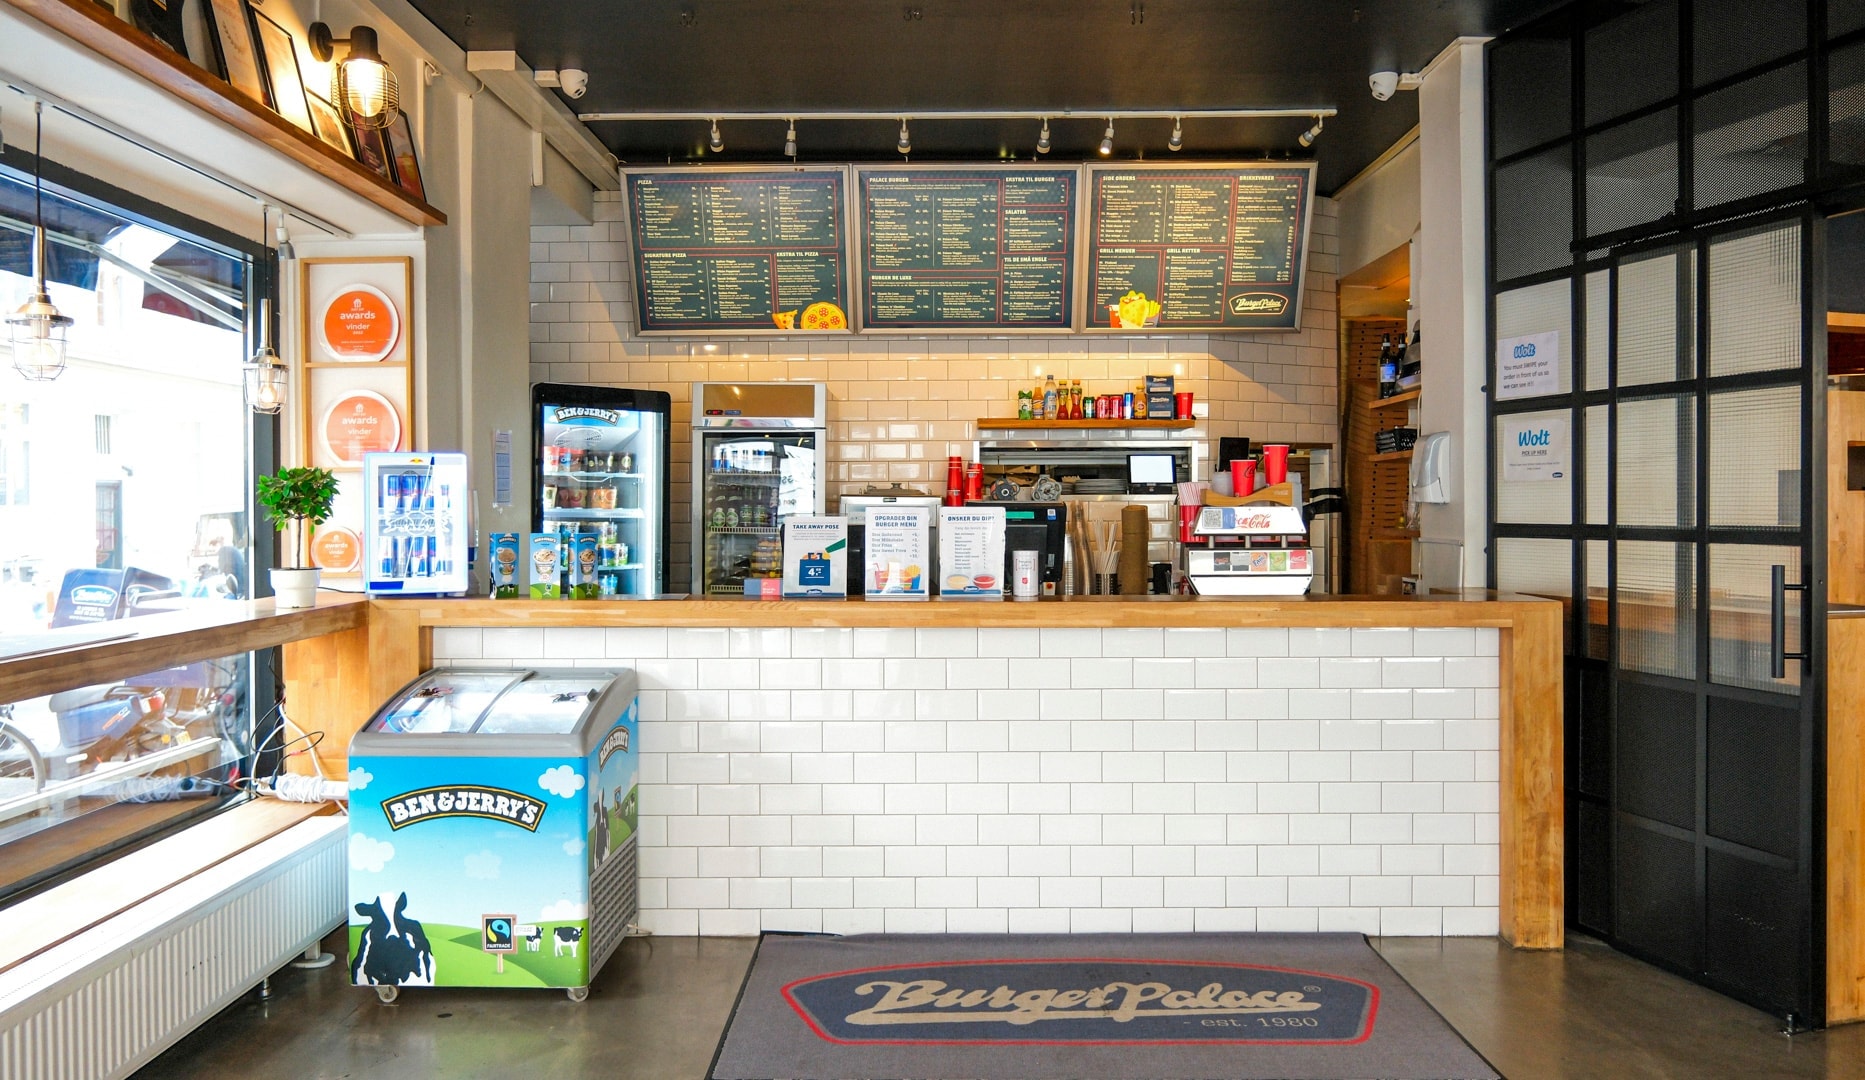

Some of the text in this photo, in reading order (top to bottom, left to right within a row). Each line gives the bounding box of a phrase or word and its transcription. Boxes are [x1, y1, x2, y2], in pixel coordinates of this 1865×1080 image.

[340, 310, 376, 320] awards
[1513, 343, 1536, 359] Wolt
[342, 416, 378, 424] awards
[1518, 429, 1550, 447] Wolt
[390, 791, 539, 824] BEN&JERRY'S
[1200, 1016, 1320, 1028] est. 1980
